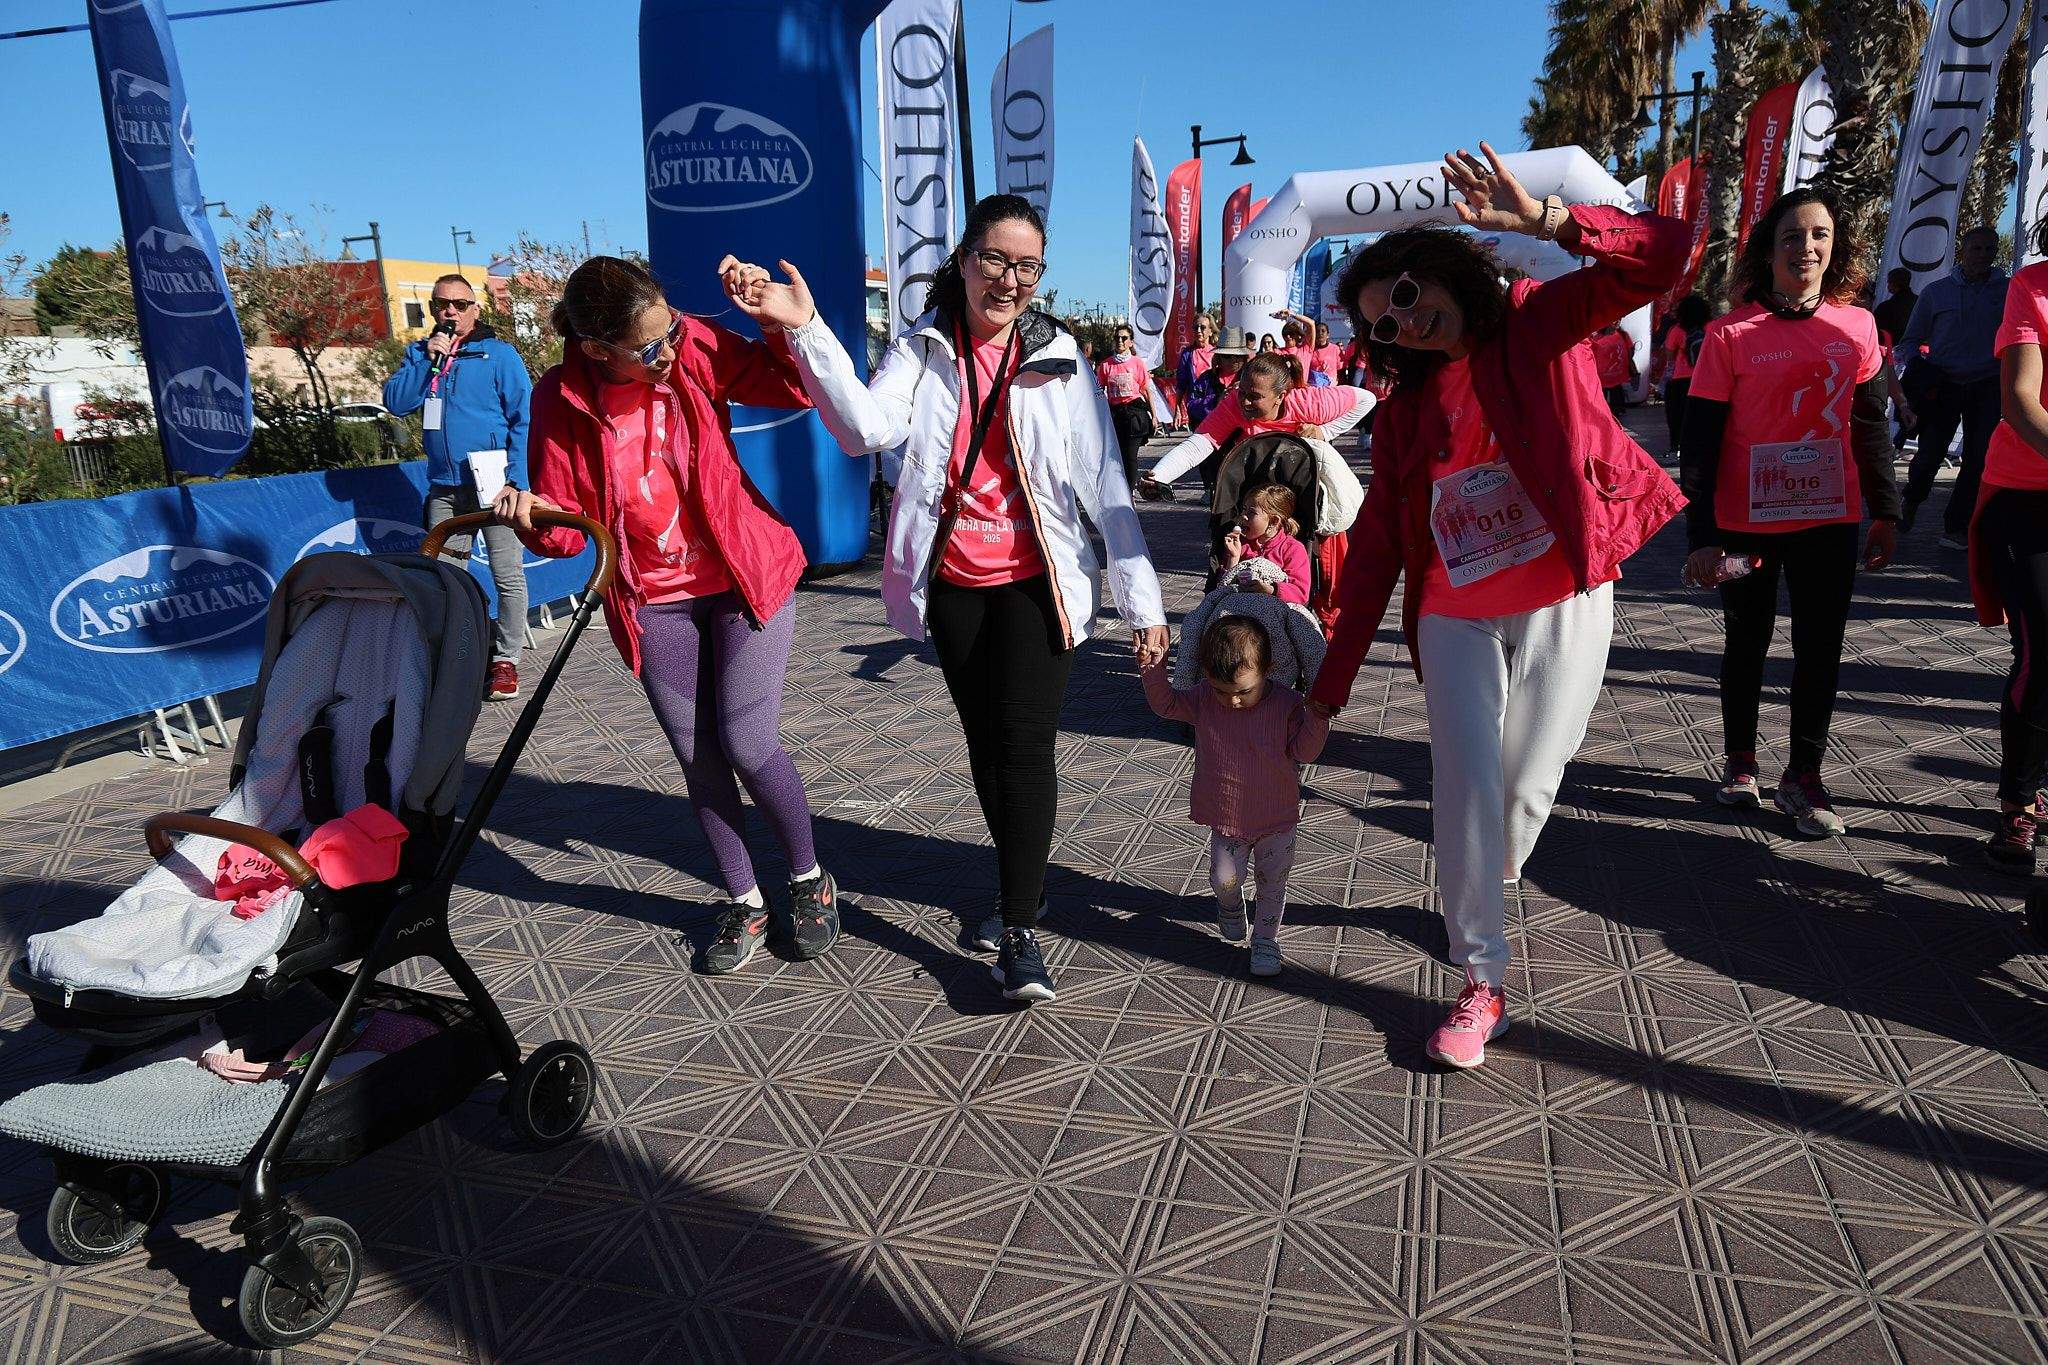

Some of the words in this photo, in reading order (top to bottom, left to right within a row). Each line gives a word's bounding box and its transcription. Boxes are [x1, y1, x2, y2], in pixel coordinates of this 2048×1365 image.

[660, 140, 714, 155] CENTRAL
[721, 140, 790, 152] LECHERA
[1898, 0, 2010, 273] OYSHO
[649, 150, 799, 190] ASTURIANA
[1750, 115, 1778, 225] Santander
[1346, 174, 1469, 216] OYSH
[1178, 185, 1193, 275] Santander
[1250, 227, 1298, 240] OYSHO
[1135, 168, 1169, 336] OYSHO
[1229, 294, 1273, 307] OYSHO
[1751, 350, 1792, 364] OYSHO
[1784, 475, 1820, 491] 016
[953, 520, 979, 532] RERA
[982, 520, 993, 532] DE
[996, 520, 1008, 532] LA
[1476, 502, 1523, 533] 016
[982, 533, 1001, 543] 2025
[1462, 557, 1499, 577] OYSHO
[103, 579, 177, 601] CENTRAL
[183, 566, 249, 586] LECHERA
[78, 580, 268, 640] ASTURIANA
[396, 917, 436, 939] nuna
